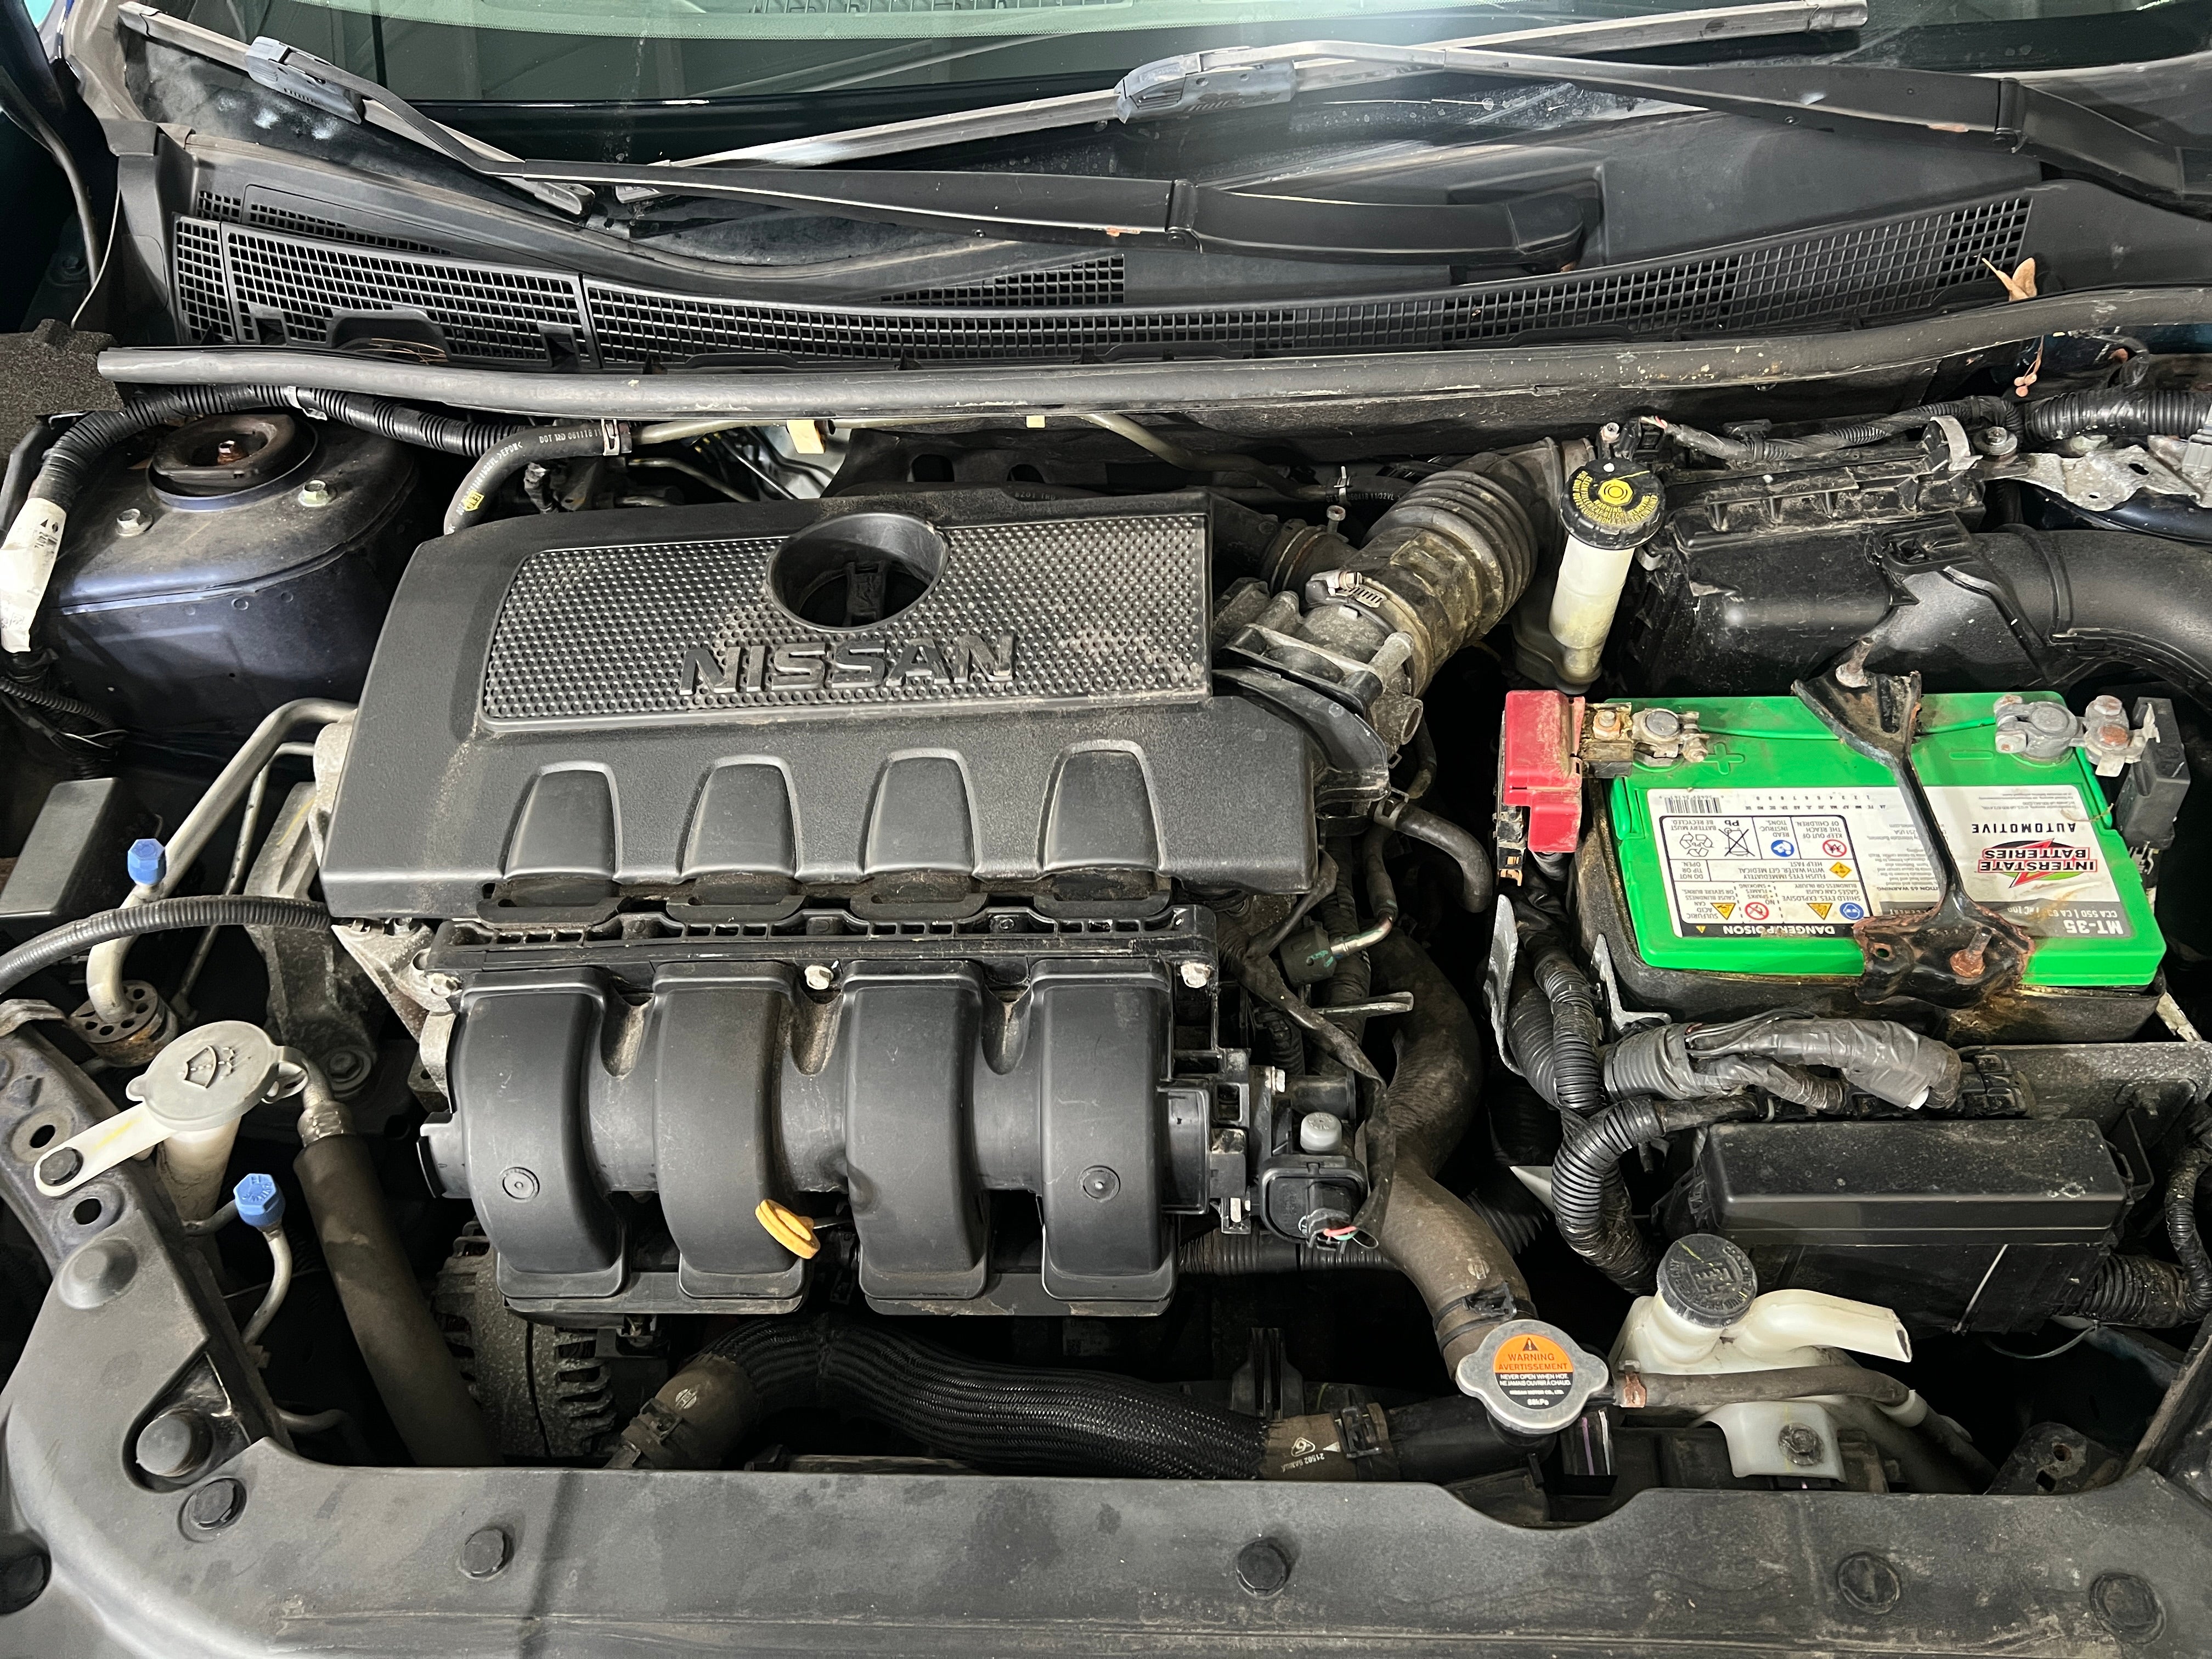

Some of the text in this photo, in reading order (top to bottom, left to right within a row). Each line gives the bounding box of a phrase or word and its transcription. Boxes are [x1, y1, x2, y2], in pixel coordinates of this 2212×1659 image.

[539, 434, 552, 443] DOT
[679, 635, 1015, 695] NISSAN
[1972, 823, 2075, 833] AUTOMOTIVE
[1984, 849, 2086, 859] BATTERIES
[1980, 861, 2094, 871] INTERSTATE
[2063, 919, 2124, 934] MT-35
[1304, 1453, 1325, 1464] 21502
